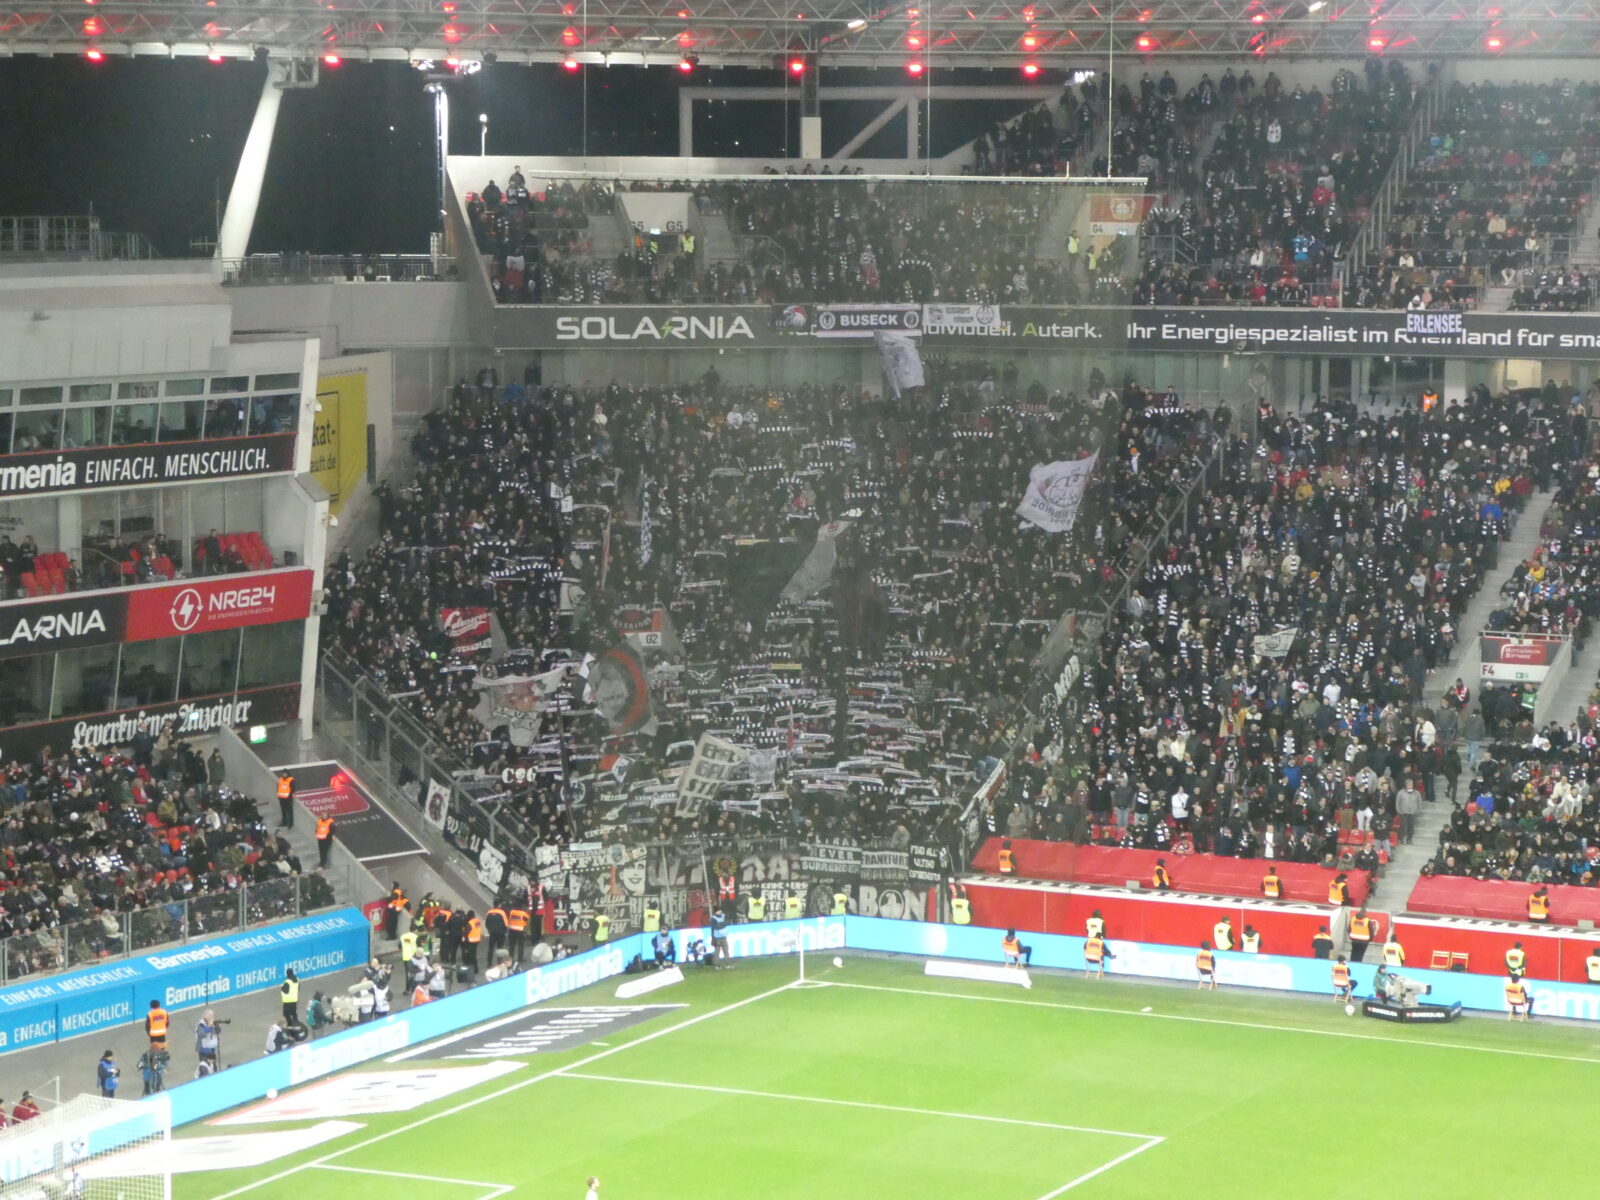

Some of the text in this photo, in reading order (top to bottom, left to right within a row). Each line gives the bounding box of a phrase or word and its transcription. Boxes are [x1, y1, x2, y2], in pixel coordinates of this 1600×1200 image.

[666, 221, 683, 232] G5
[556, 316, 755, 339] SOLARNIA
[840, 314, 898, 326] BUSECK
[1022, 322, 1102, 339] Autark.
[1406, 314, 1462, 334] ERLENSEE
[1127, 323, 1156, 338] Ihr
[1162, 324, 1357, 343] Energiespezialist
[1363, 327, 1388, 342] im
[1395, 328, 1511, 346] Rland
[1517, 329, 1554, 346] für
[0, 448, 269, 491] menia EINFACH. MENSCHLICH.
[209, 585, 275, 612] NRG24
[1482, 665, 1495, 676] F4
[678, 917, 845, 963] Brmenia
[57, 966, 142, 992] MENSCHLICH.
[147, 943, 227, 970] Barmenia
[228, 933, 281, 952] EINFACH.
[279, 916, 352, 939] MENSCHLICH.
[527, 944, 622, 999] Barmenia
[62, 1002, 133, 1032] MENSCHLICH.
[166, 974, 230, 1006] Barmenia
[285, 949, 347, 980] MENSCHLICH.
